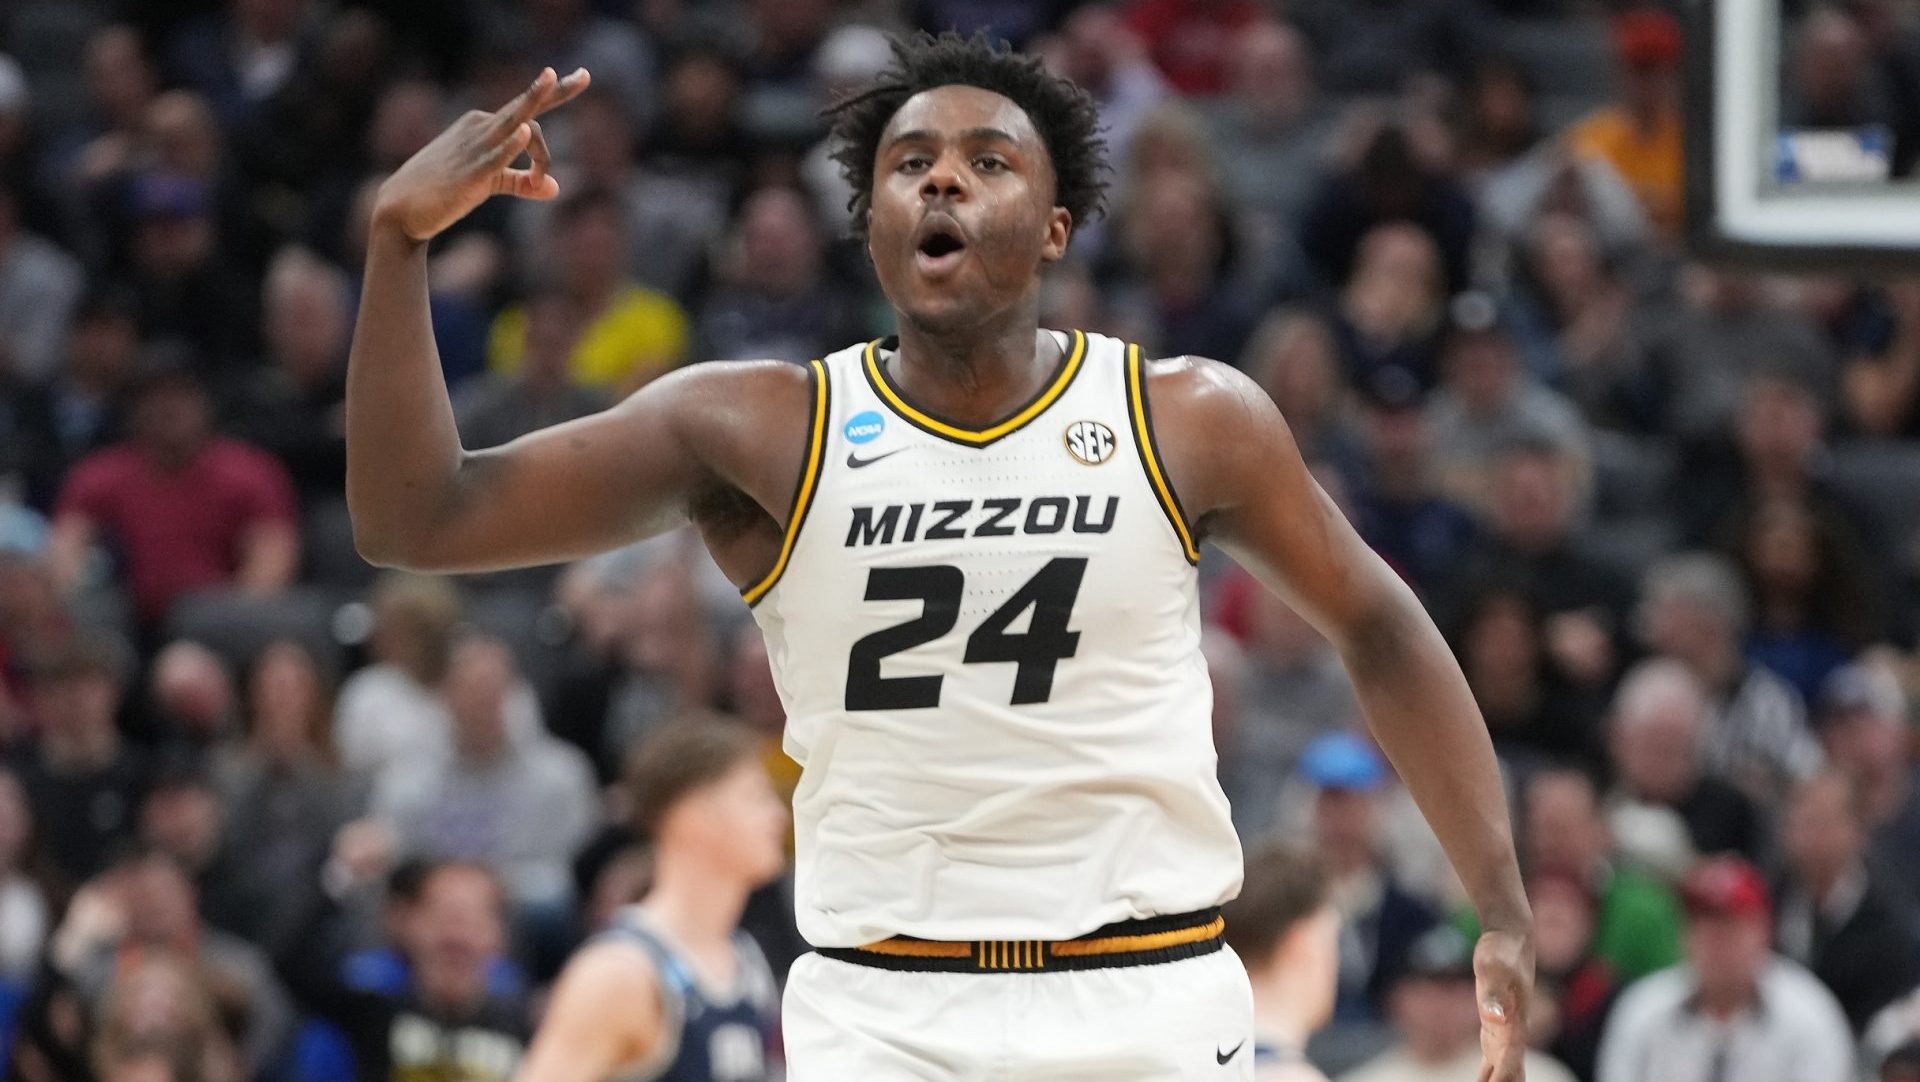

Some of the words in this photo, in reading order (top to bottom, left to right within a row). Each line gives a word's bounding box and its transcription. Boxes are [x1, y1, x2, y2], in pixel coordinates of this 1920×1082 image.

[1067, 421, 1114, 462] SEC
[845, 496, 1119, 547] MIZZOU
[845, 557, 1088, 711] 24
